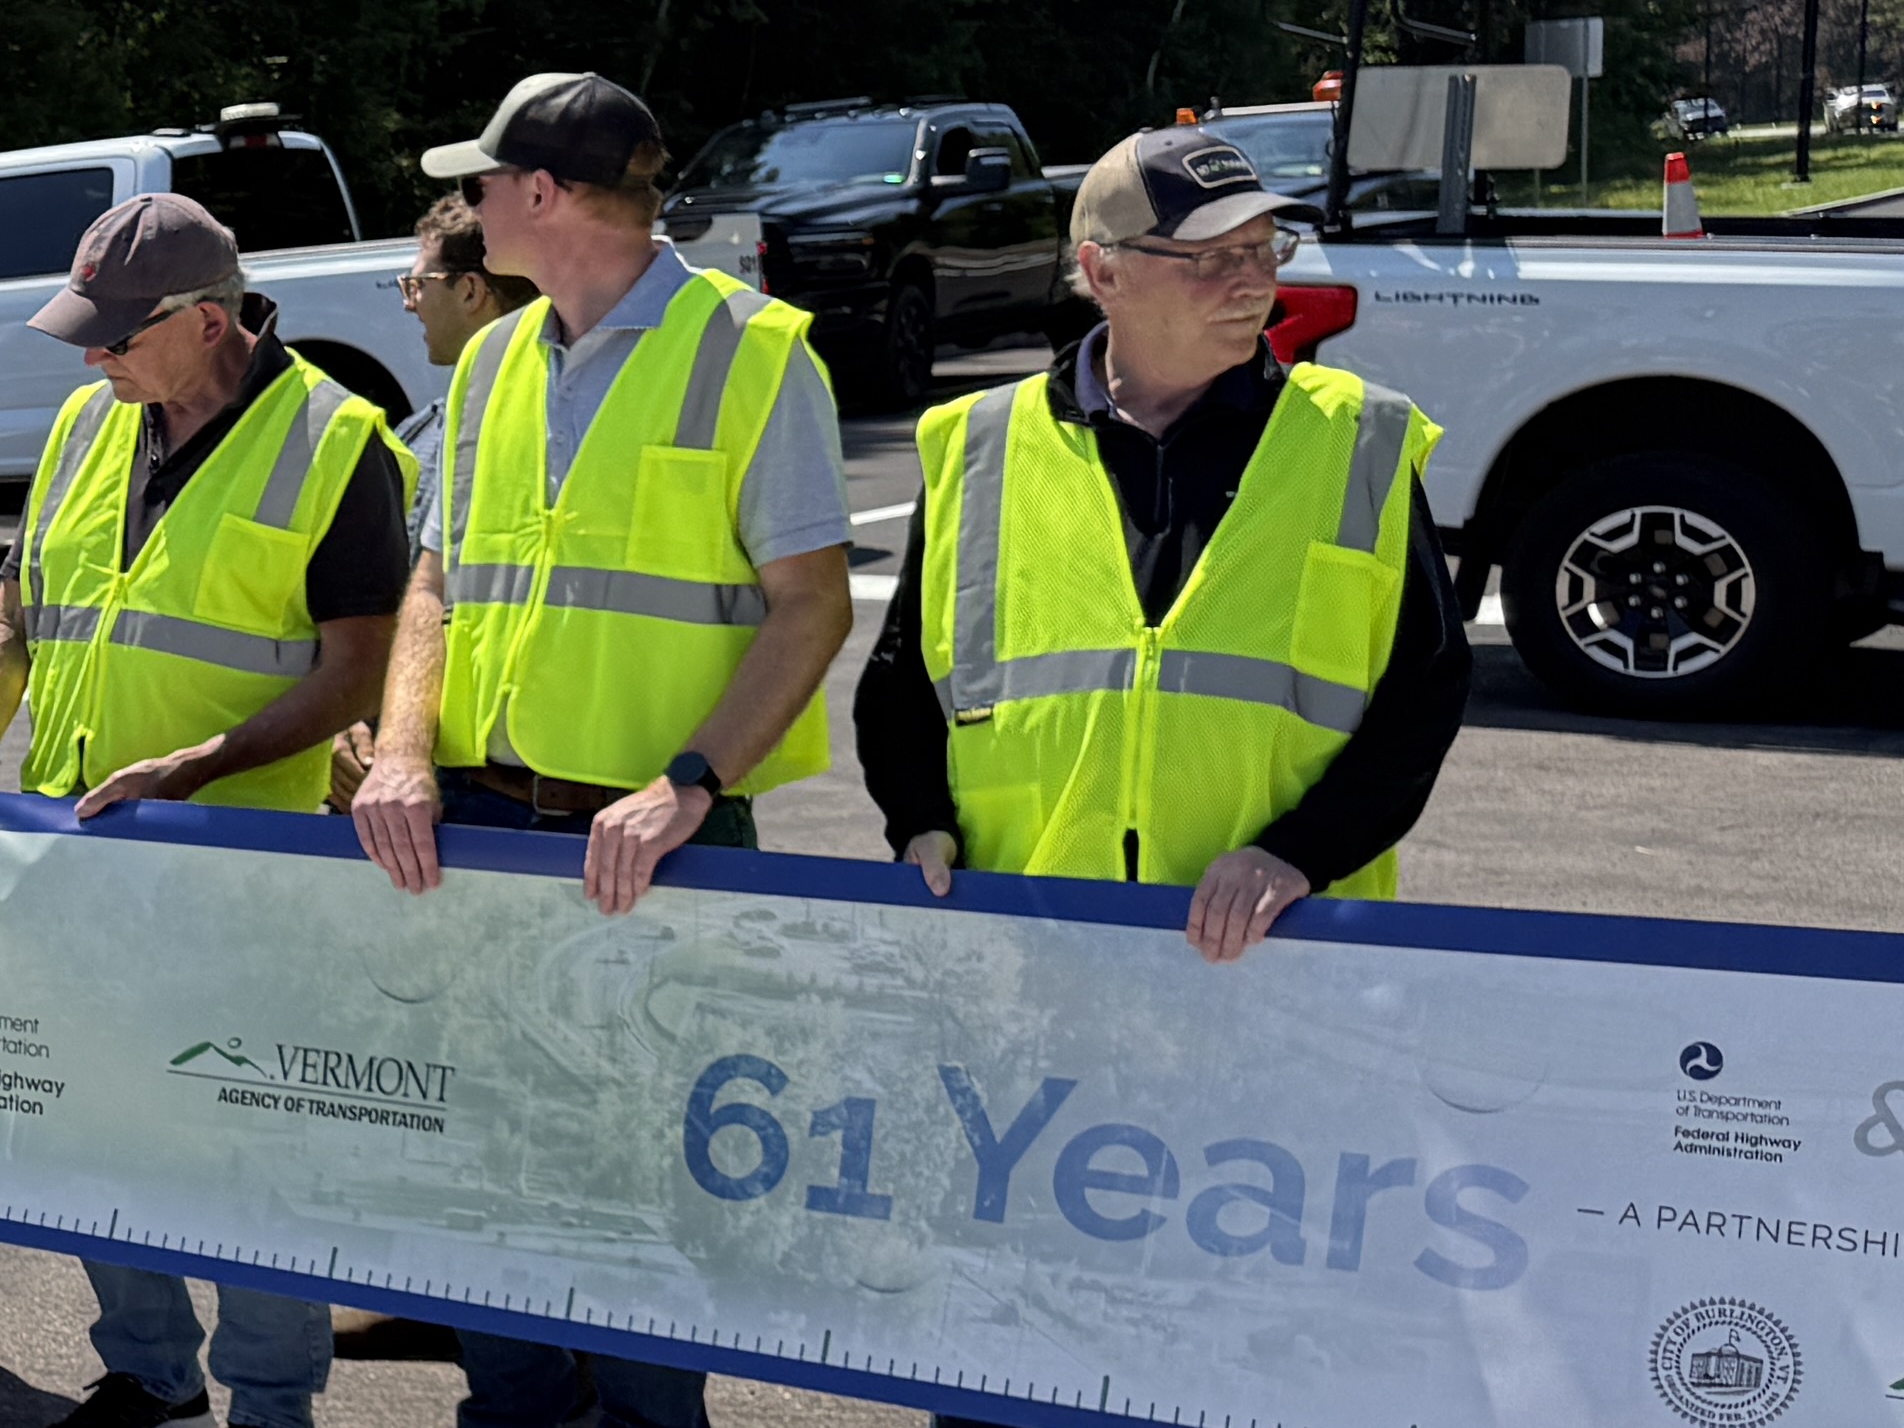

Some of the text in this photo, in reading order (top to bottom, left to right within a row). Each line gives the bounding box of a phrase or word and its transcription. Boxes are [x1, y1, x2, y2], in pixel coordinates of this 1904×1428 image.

[1374, 290, 1540, 307] LIGHTNING
[275, 1043, 456, 1103] VERMONT
[217, 1086, 445, 1134] AGENCY OF TRANSPORTATION
[1700, 1090, 1782, 1111] Department
[1675, 1105, 1790, 1127] of Transportation
[1673, 1140, 1783, 1163] Administration
[1674, 1125, 1802, 1152] Federal Highway
[683, 1053, 1532, 1292] 61 Years
[1618, 1202, 1642, 1228] A
[1661, 1337, 1677, 1371] CITY
[1673, 1317, 1691, 1337] OF
